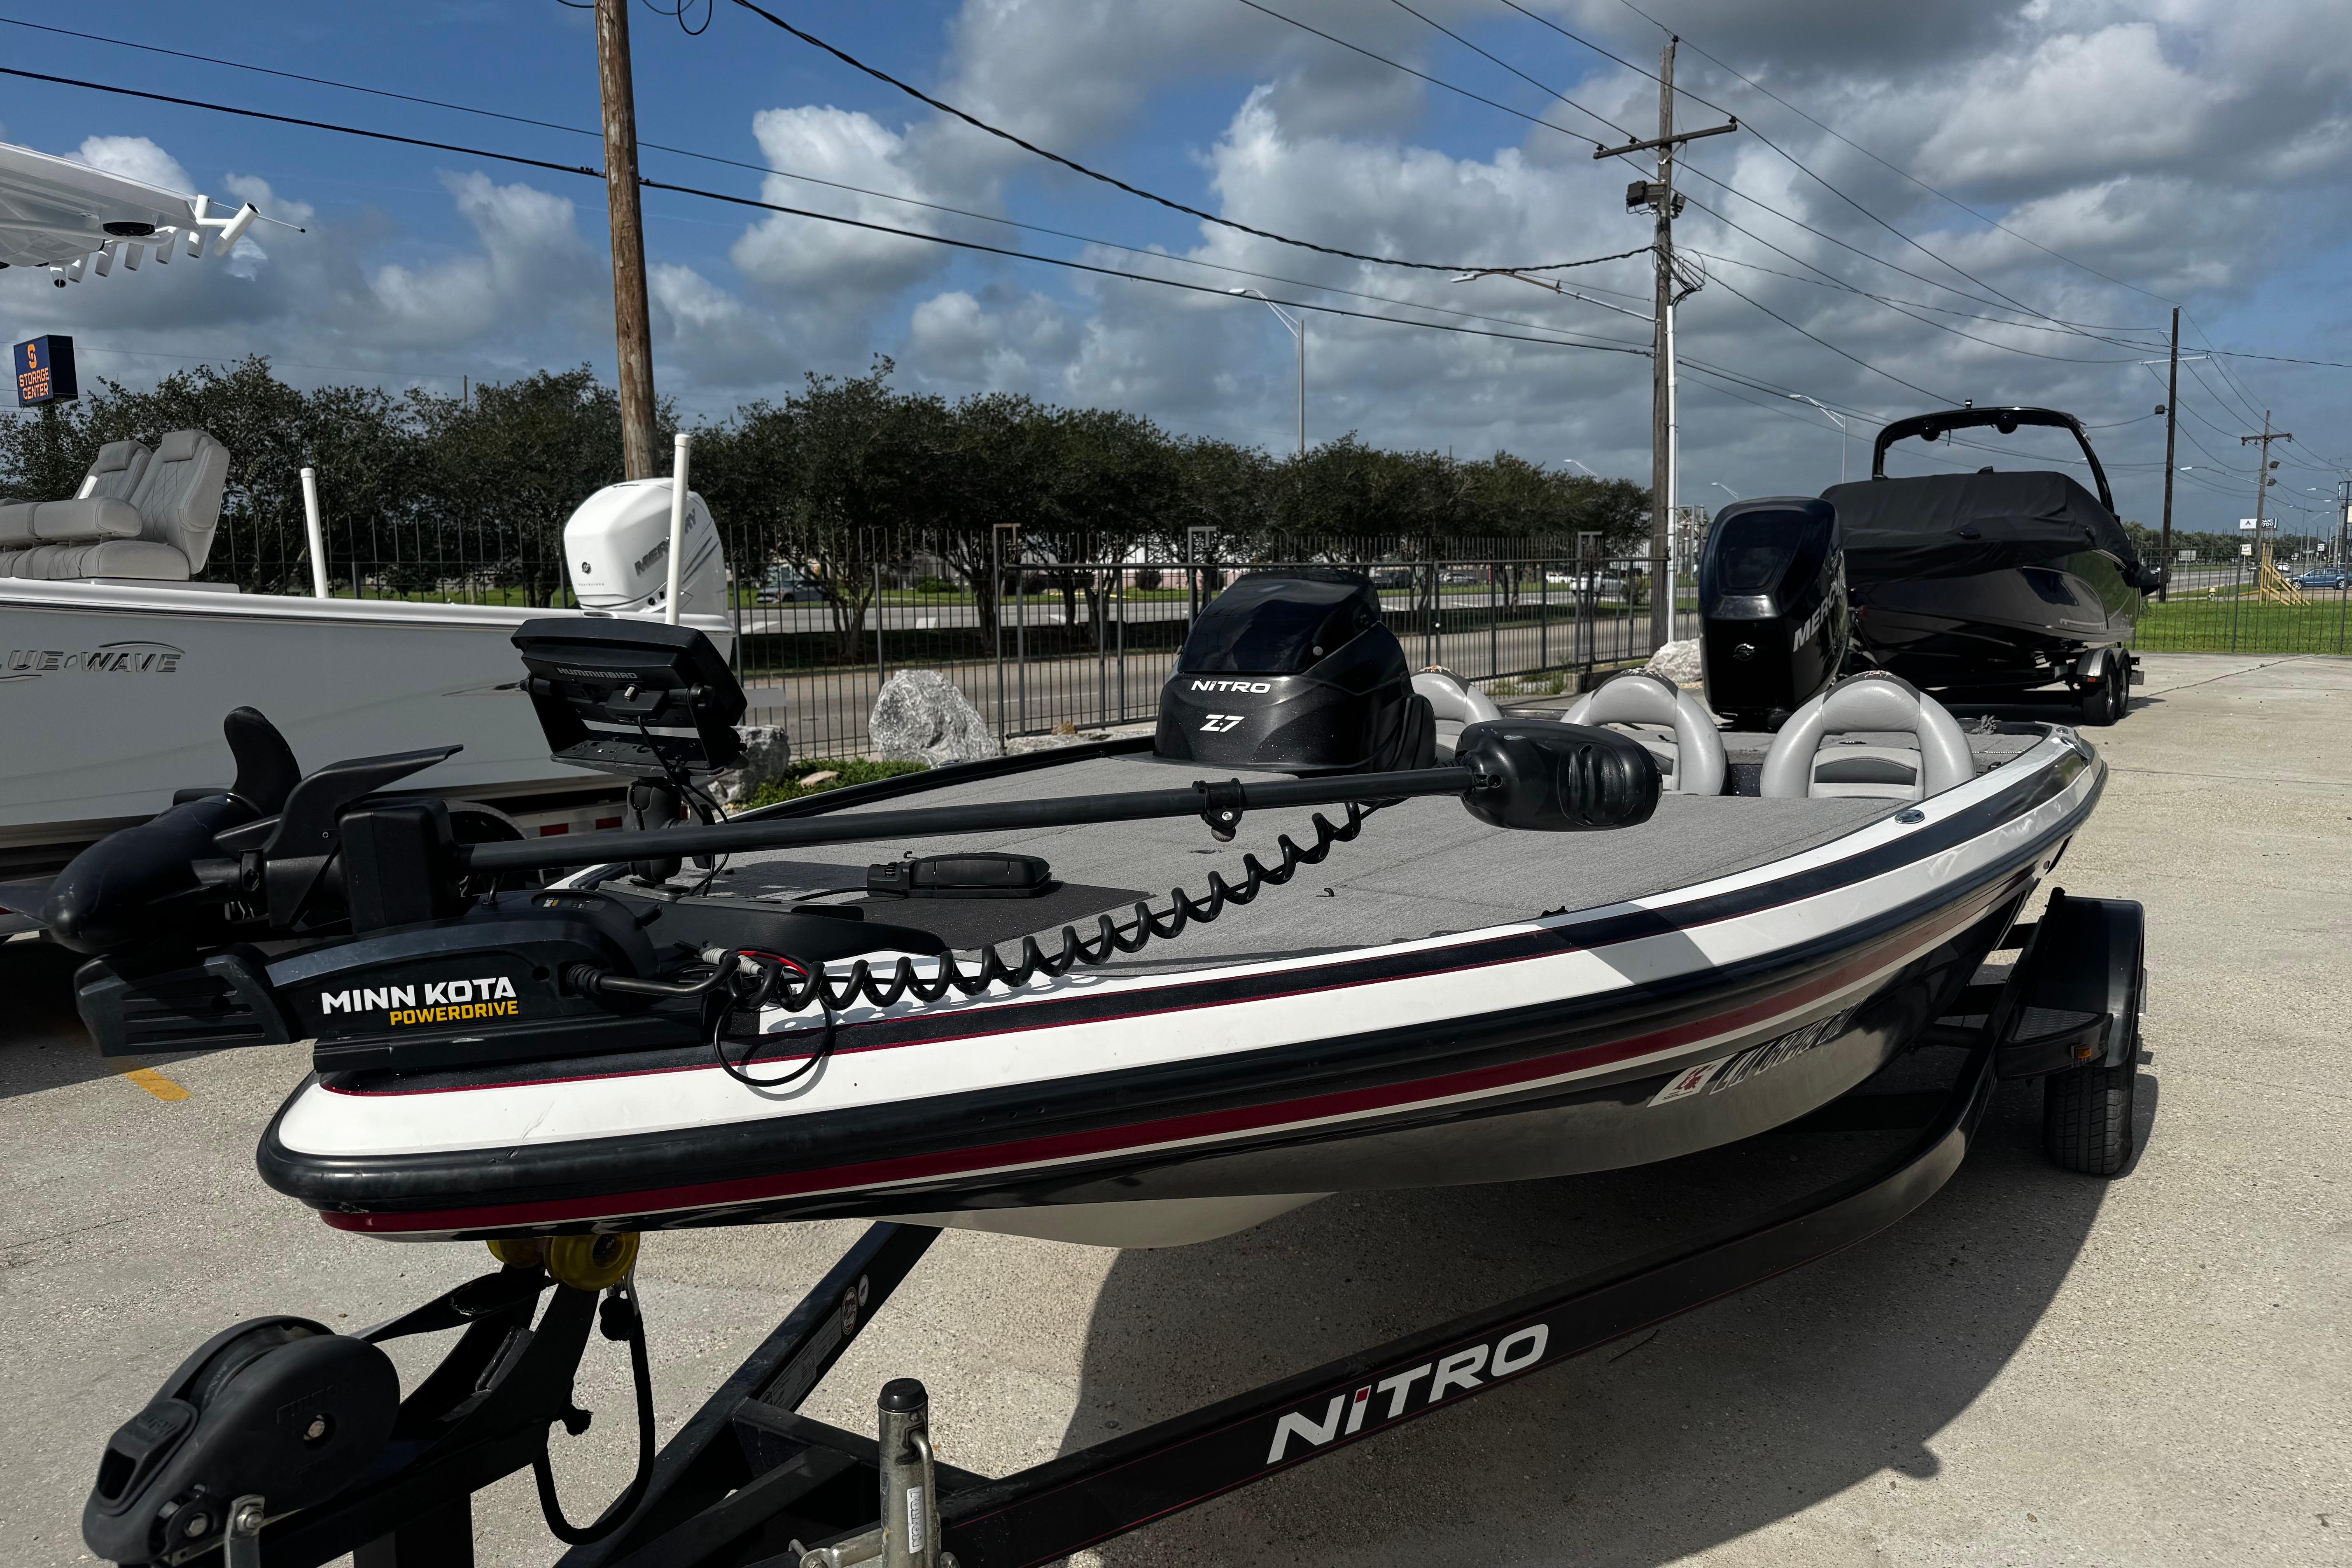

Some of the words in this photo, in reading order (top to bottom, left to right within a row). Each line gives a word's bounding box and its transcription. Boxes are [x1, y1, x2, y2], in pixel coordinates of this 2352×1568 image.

[19, 367, 49, 387] STORAGE
[23, 382, 49, 400] CENTER
[635, 508, 696, 576] MERRY
[81, 651, 181, 672] WAVE
[556, 667, 638, 679] HUMMINBIRD
[1191, 680, 1271, 693] NITRO
[322, 985, 416, 1014] MINN
[425, 977, 516, 1005] KOTA
[390, 1001, 518, 1025] POWERDRIVE
[1266, 1323, 1549, 1465] NITRO
[910, 1491, 923, 1547] FULTON
